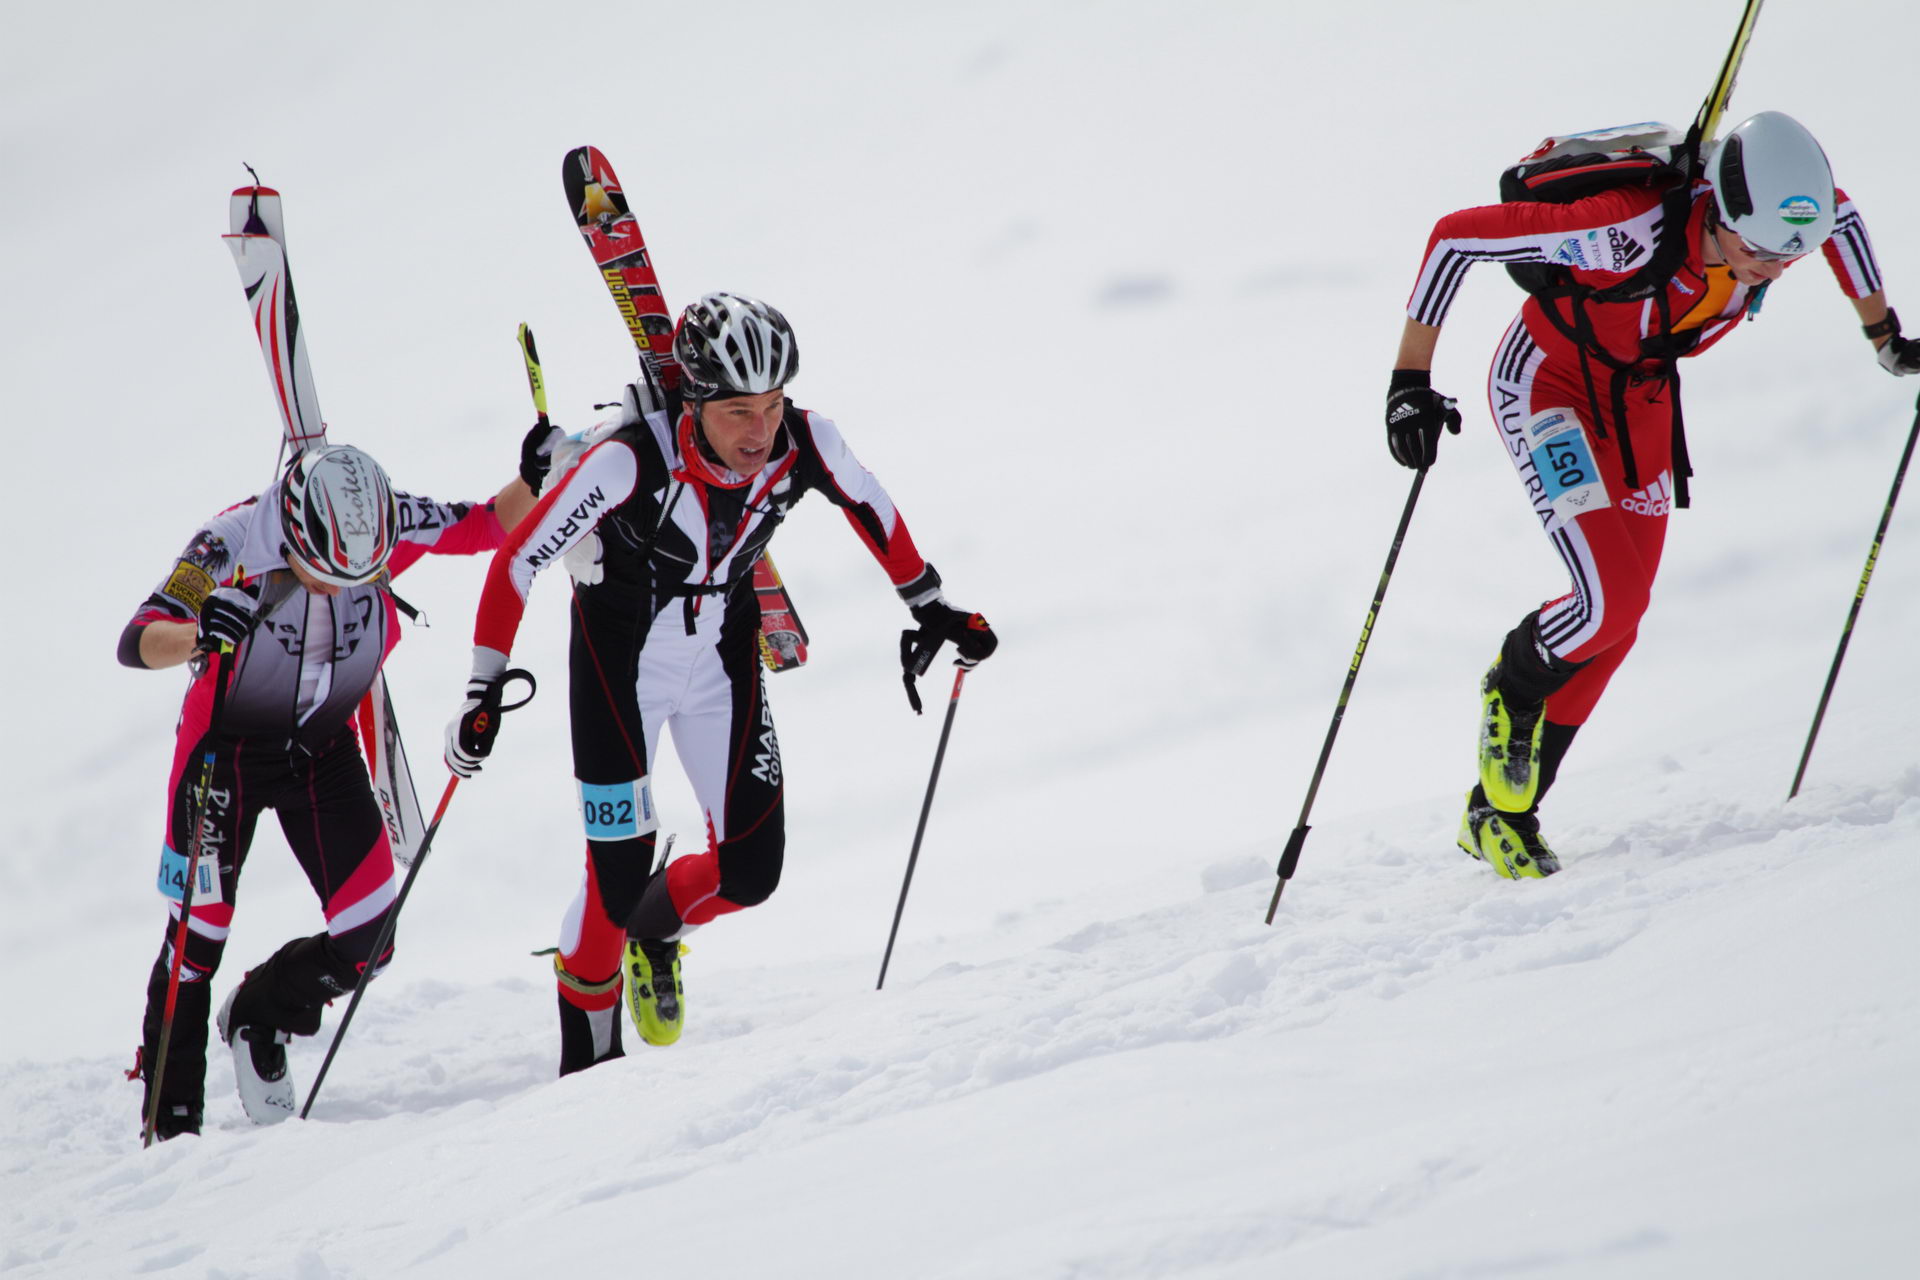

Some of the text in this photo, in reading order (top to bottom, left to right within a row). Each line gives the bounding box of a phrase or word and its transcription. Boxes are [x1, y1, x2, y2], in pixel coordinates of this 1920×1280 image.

[1389, 408, 1420, 424] adidas
[1496, 386, 1556, 528] AUSTRIA
[1545, 441, 1584, 487] 057
[325, 452, 371, 537] Biotech
[1620, 497, 1671, 517] adida
[525, 485, 606, 568] MARTIN
[584, 799, 634, 827] 082
